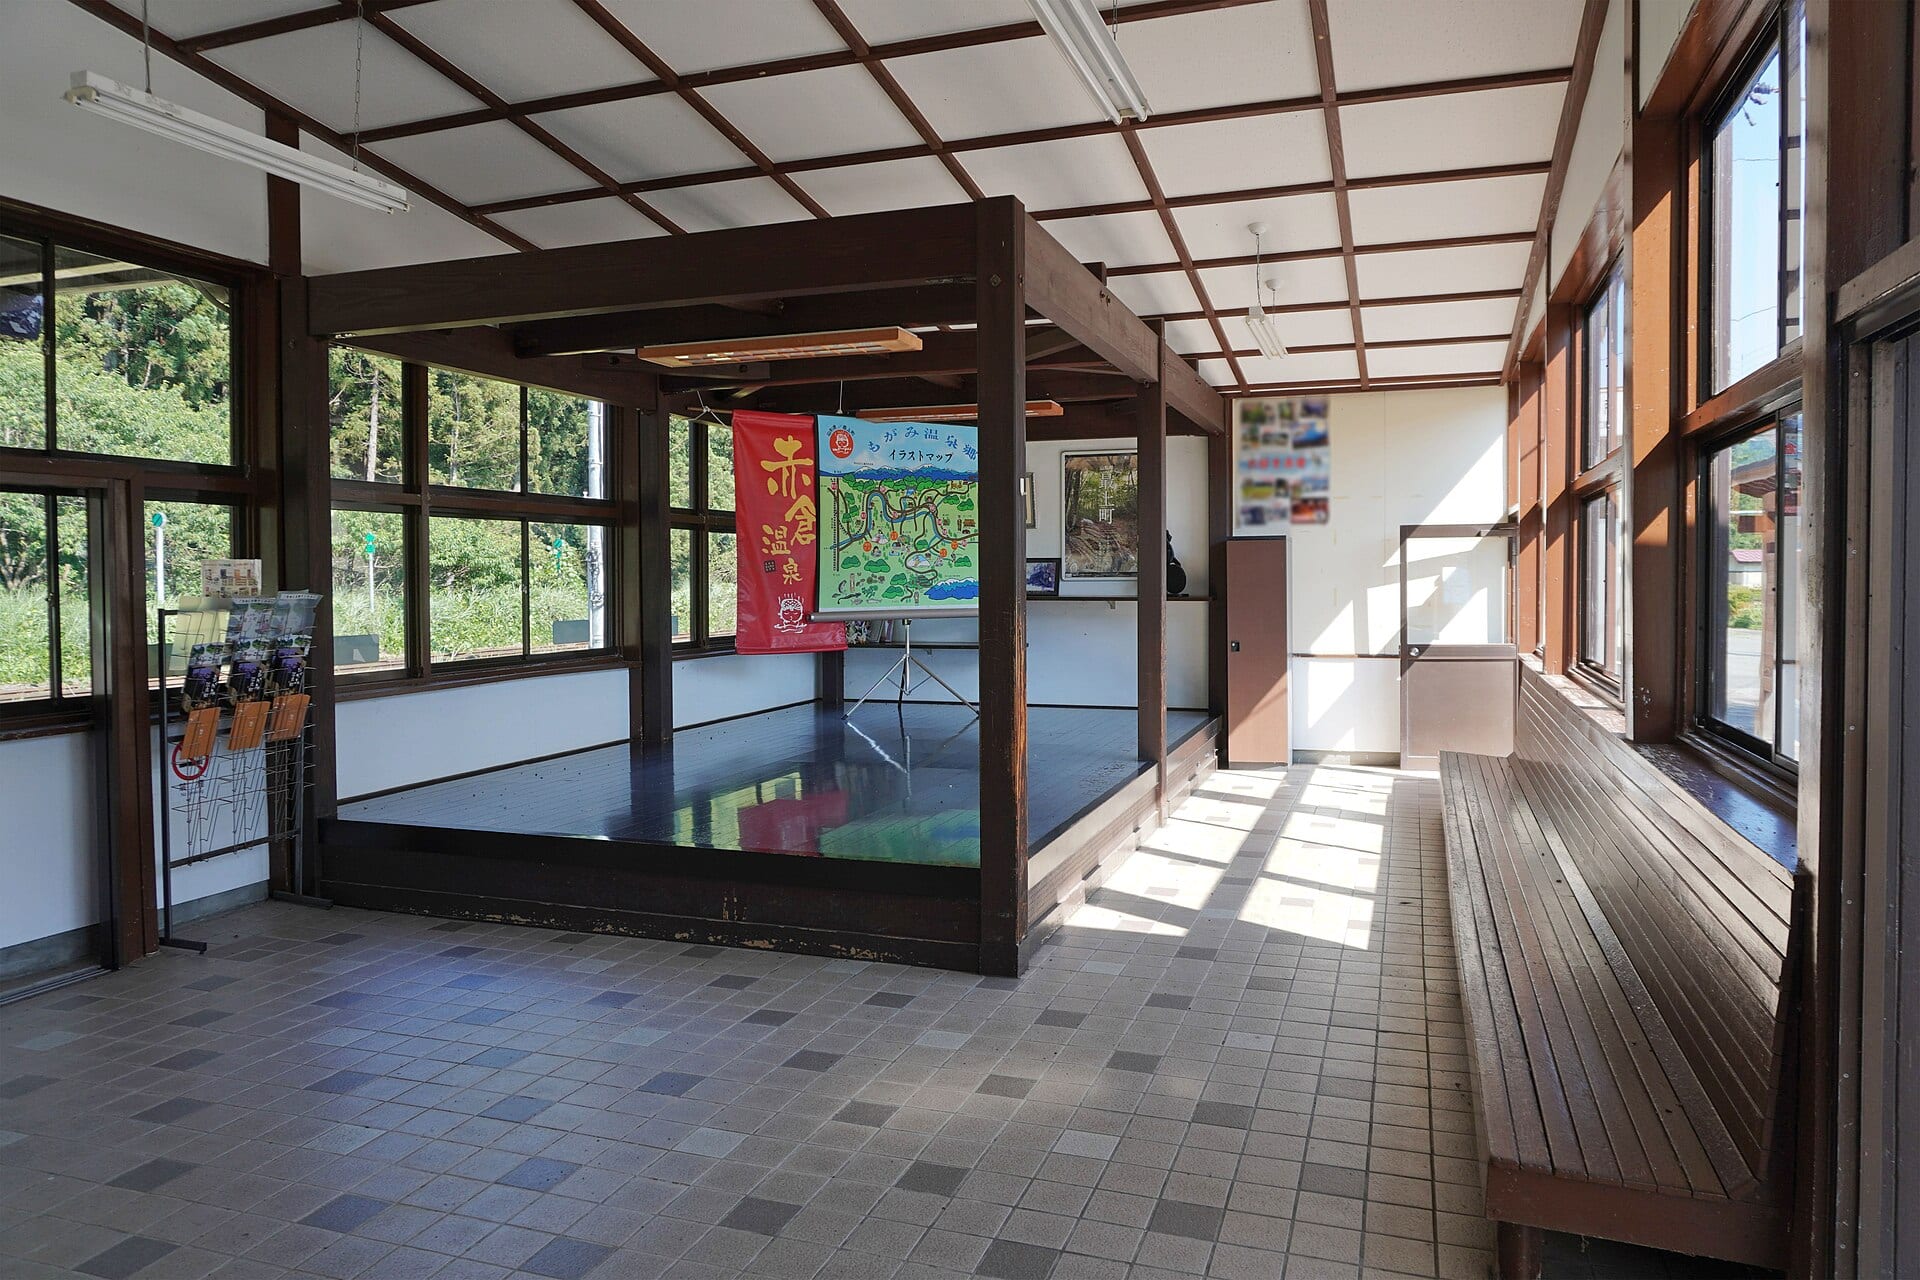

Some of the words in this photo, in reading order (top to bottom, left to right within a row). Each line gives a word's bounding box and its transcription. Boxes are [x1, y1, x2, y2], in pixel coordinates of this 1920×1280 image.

[889, 449, 953, 463] イラストマップ
